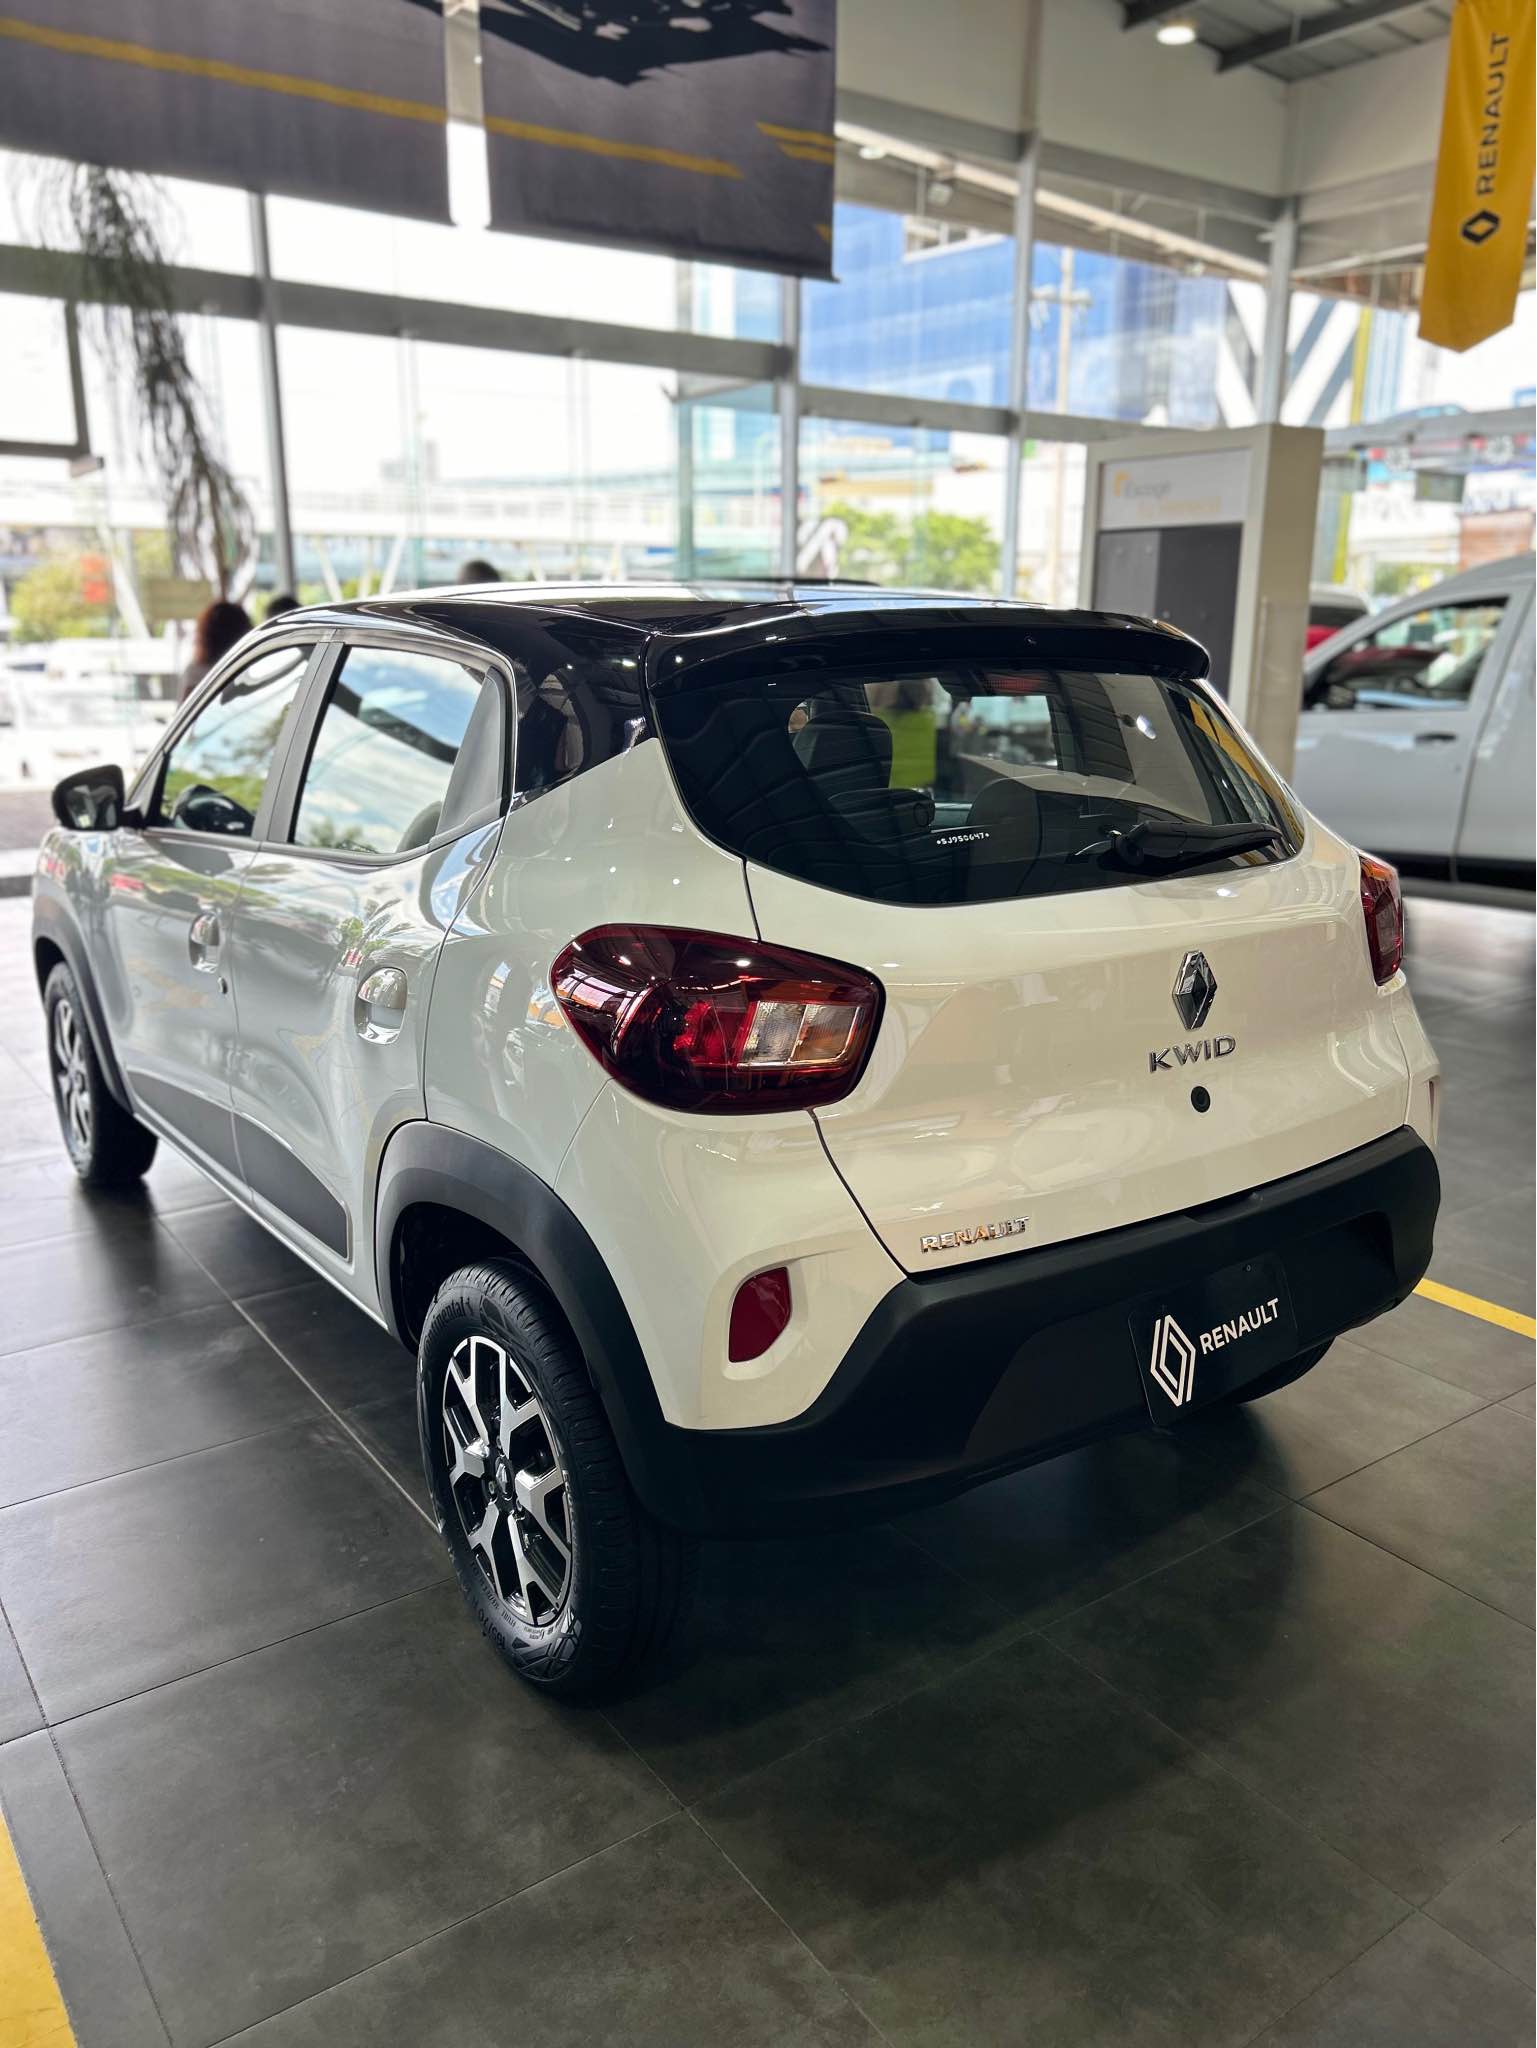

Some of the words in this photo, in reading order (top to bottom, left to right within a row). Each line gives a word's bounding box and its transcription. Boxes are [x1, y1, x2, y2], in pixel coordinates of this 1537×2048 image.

[1476, 31, 1509, 196] RENAULT
[1149, 1035, 1236, 1073] KWID
[920, 1216, 1031, 1253] RENAULT
[1199, 1297, 1279, 1355] RENAULT
